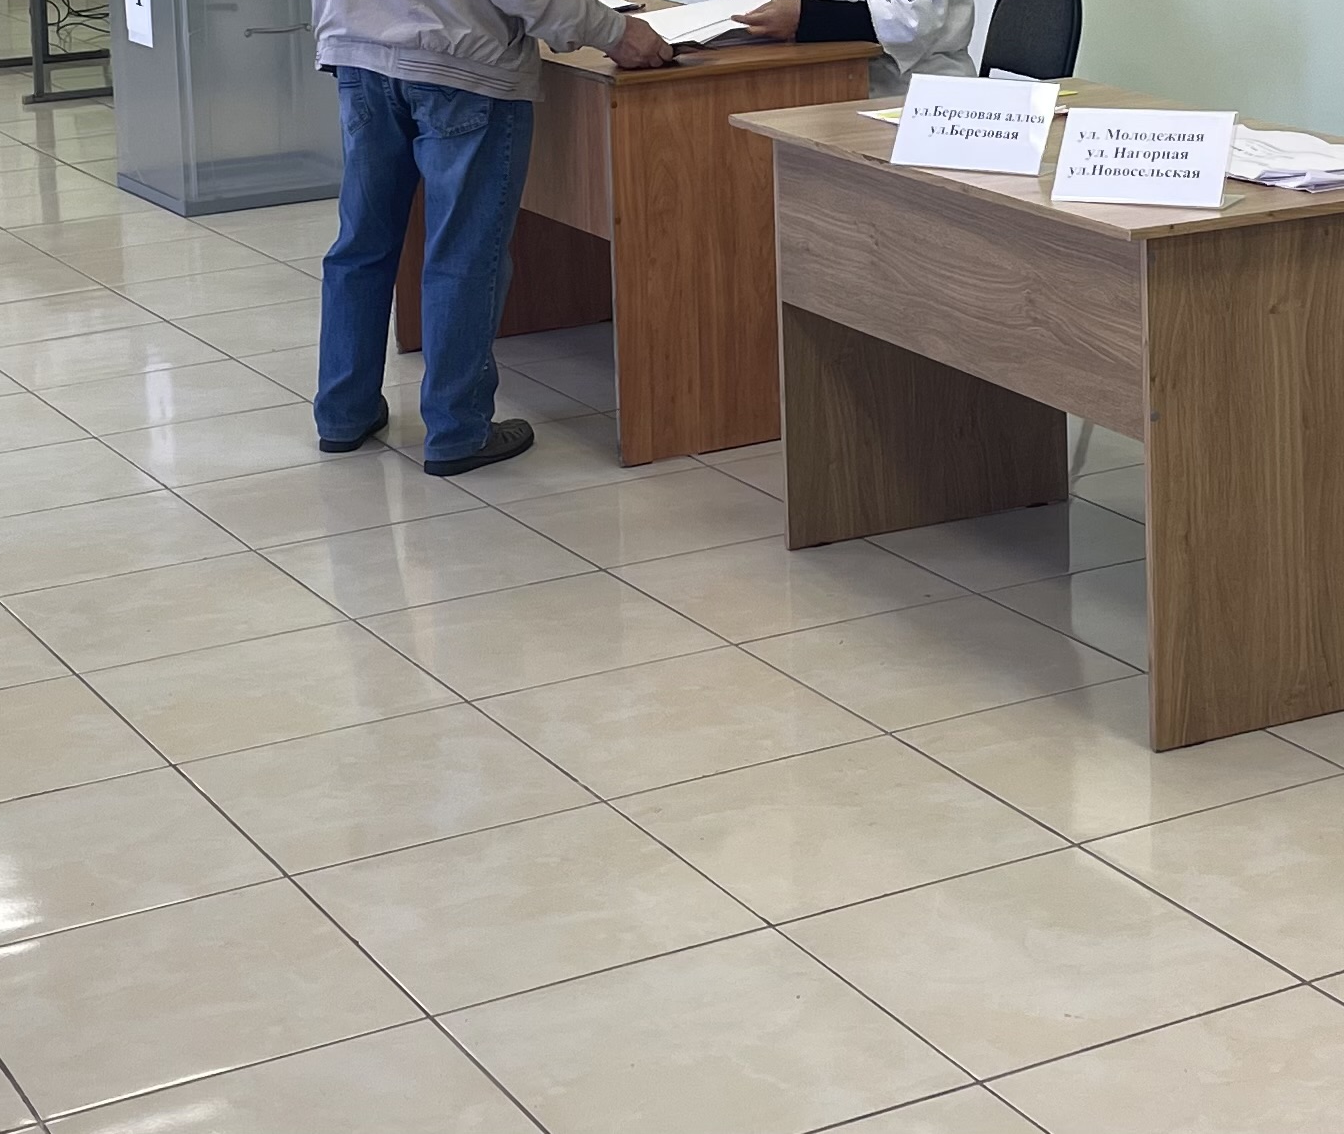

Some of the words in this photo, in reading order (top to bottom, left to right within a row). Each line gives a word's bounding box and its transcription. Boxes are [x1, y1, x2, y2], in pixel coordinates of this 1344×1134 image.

[928, 124, 1020, 141] ул.Березовая
[1076, 130, 1101, 143] ул.
[1106, 128, 1205, 142] Молодежная
[1084, 147, 1109, 161] ул.
[1113, 146, 1190, 163] Нагорная
[1067, 164, 1201, 179] ул.Новосельская
